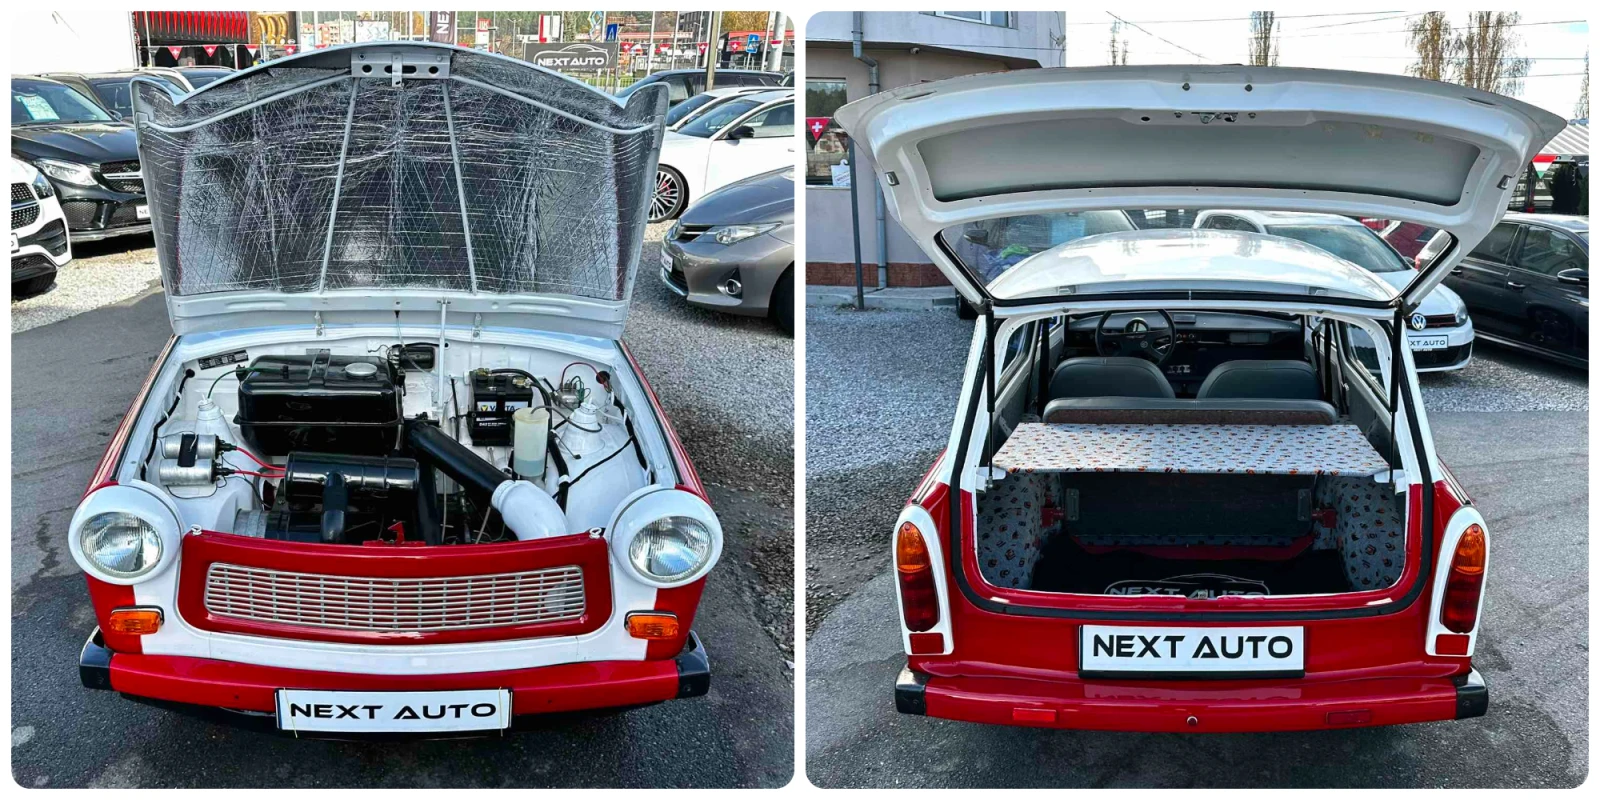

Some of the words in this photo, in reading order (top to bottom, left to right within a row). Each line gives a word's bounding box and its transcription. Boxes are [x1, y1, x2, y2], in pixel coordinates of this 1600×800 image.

[436, 11, 450, 34] NE
[537, 57, 570, 66] NEXT
[570, 57, 605, 66] AUTO
[1093, 633, 1186, 659] NEXT
[1191, 635, 1294, 660] AUTO
[290, 702, 384, 719] NEXT
[393, 702, 497, 720] AUTO
